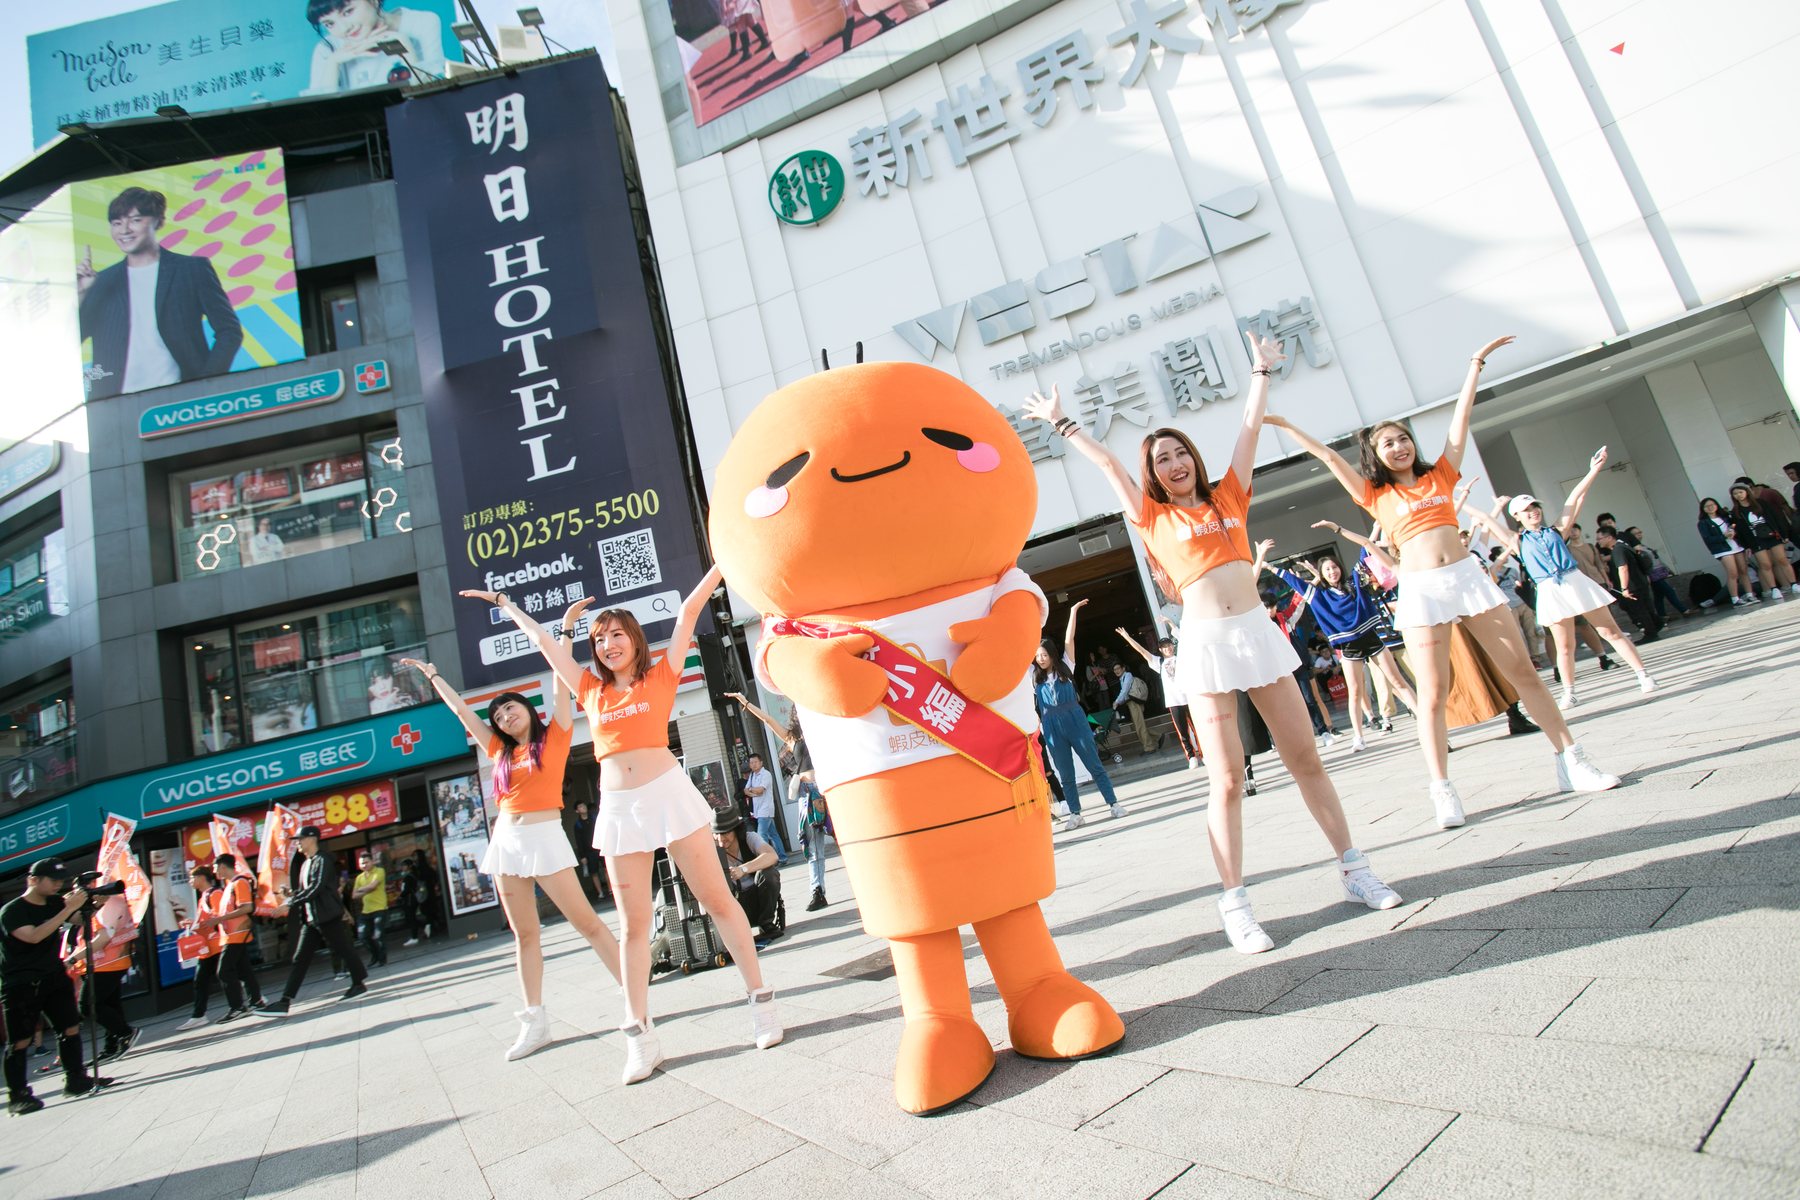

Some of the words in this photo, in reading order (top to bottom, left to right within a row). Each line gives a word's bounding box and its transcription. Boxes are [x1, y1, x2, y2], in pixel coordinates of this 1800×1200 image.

[465, 92, 530, 223] 明日
[484, 235, 577, 483] HOTEL
[988, 312, 1142, 381] TREMENDOUS
[1150, 282, 1224, 323] MEDIA
[154, 393, 263, 427] watsons
[466, 488, 660, 568] (02)2375-5500
[524, 581, 585, 614] 粉絲團
[158, 760, 284, 803] watsons
[299, 741, 357, 771] 屈臣氏
[325, 793, 370, 825] 88
